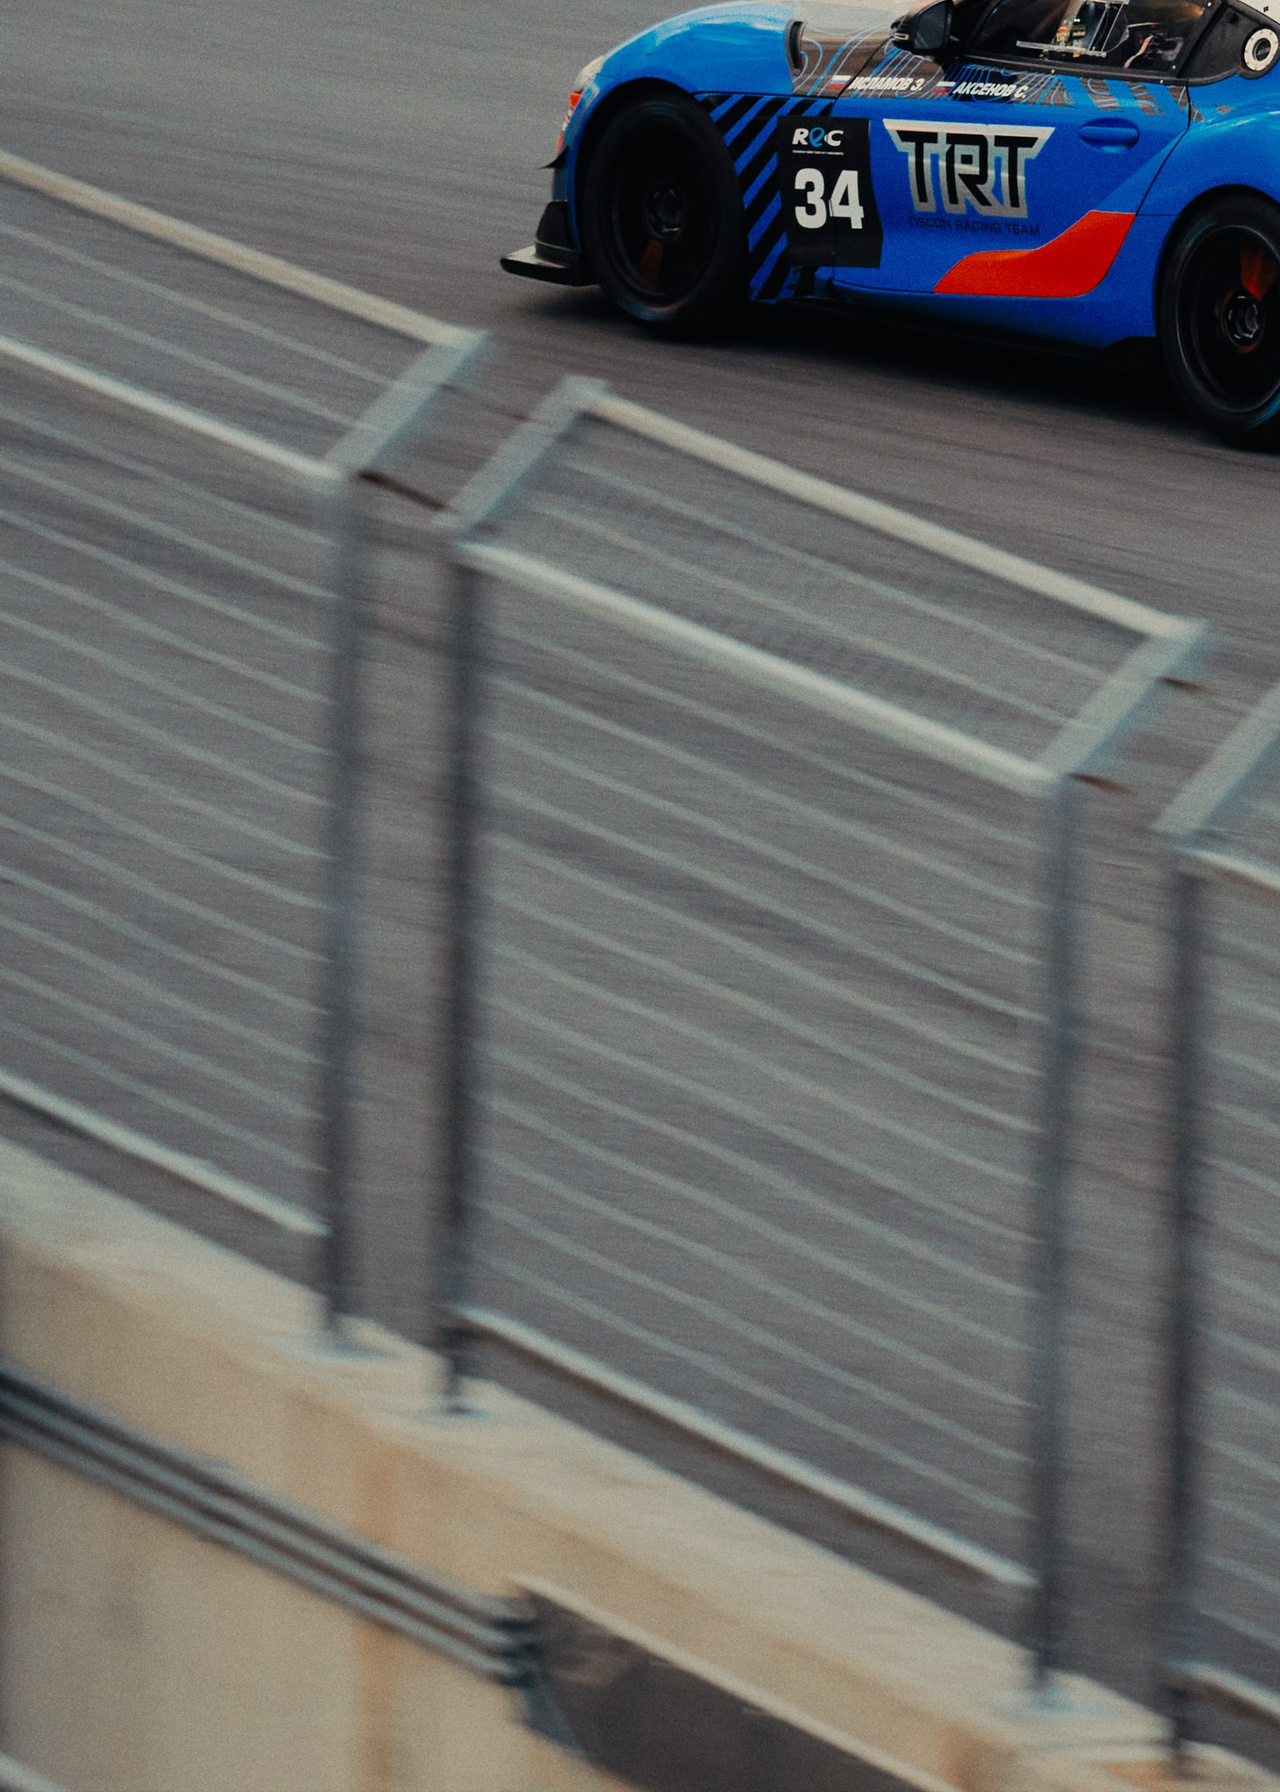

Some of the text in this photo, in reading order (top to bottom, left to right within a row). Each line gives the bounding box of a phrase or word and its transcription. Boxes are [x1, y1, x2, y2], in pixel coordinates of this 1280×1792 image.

[952, 81, 1017, 97] АКСЕНОВ
[882, 118, 1055, 218] TRT
[794, 167, 864, 229] 34
[954, 219, 1002, 233] RACING
[1004, 223, 1040, 237] TEAM
